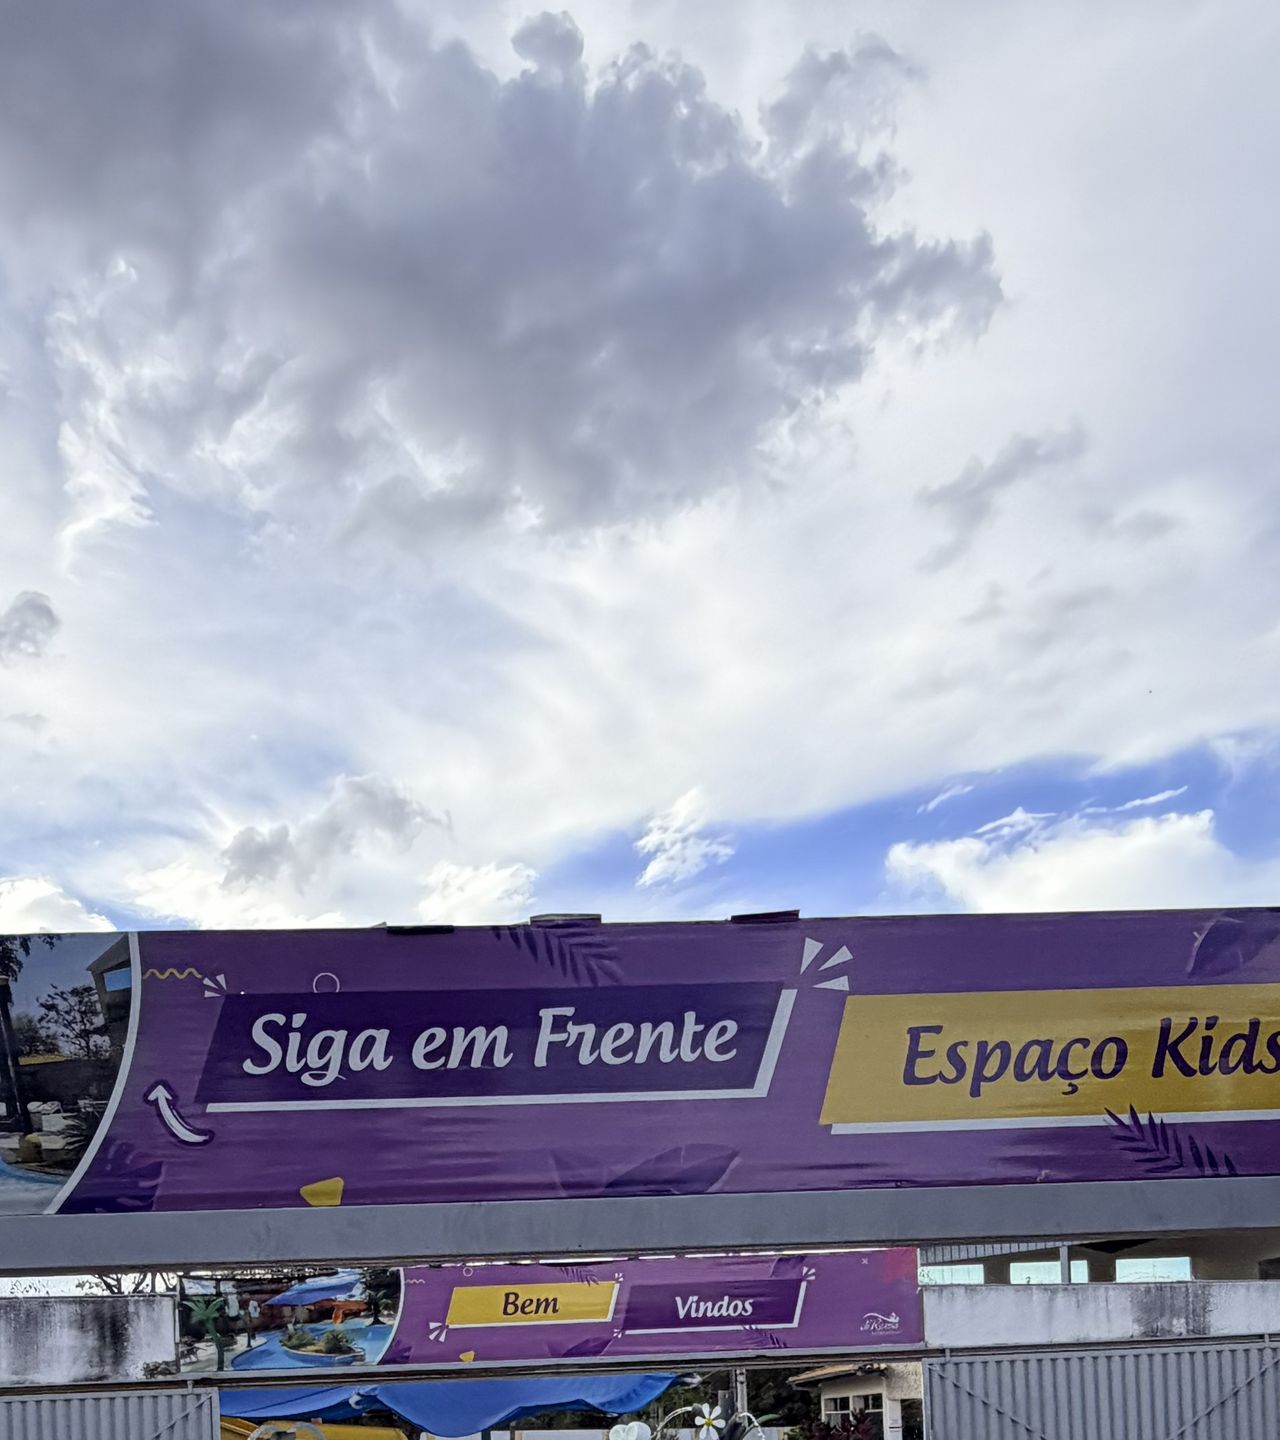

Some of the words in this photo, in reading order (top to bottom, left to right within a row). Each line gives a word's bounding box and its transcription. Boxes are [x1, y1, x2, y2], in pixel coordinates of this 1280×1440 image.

[242, 1012, 393, 1087] Siga
[411, 1025, 513, 1069] em
[533, 1006, 738, 1067] Frente
[902, 1025, 1128, 1097] Espaço
[502, 1292, 559, 1316] Bem
[674, 1295, 753, 1319] Vindos
